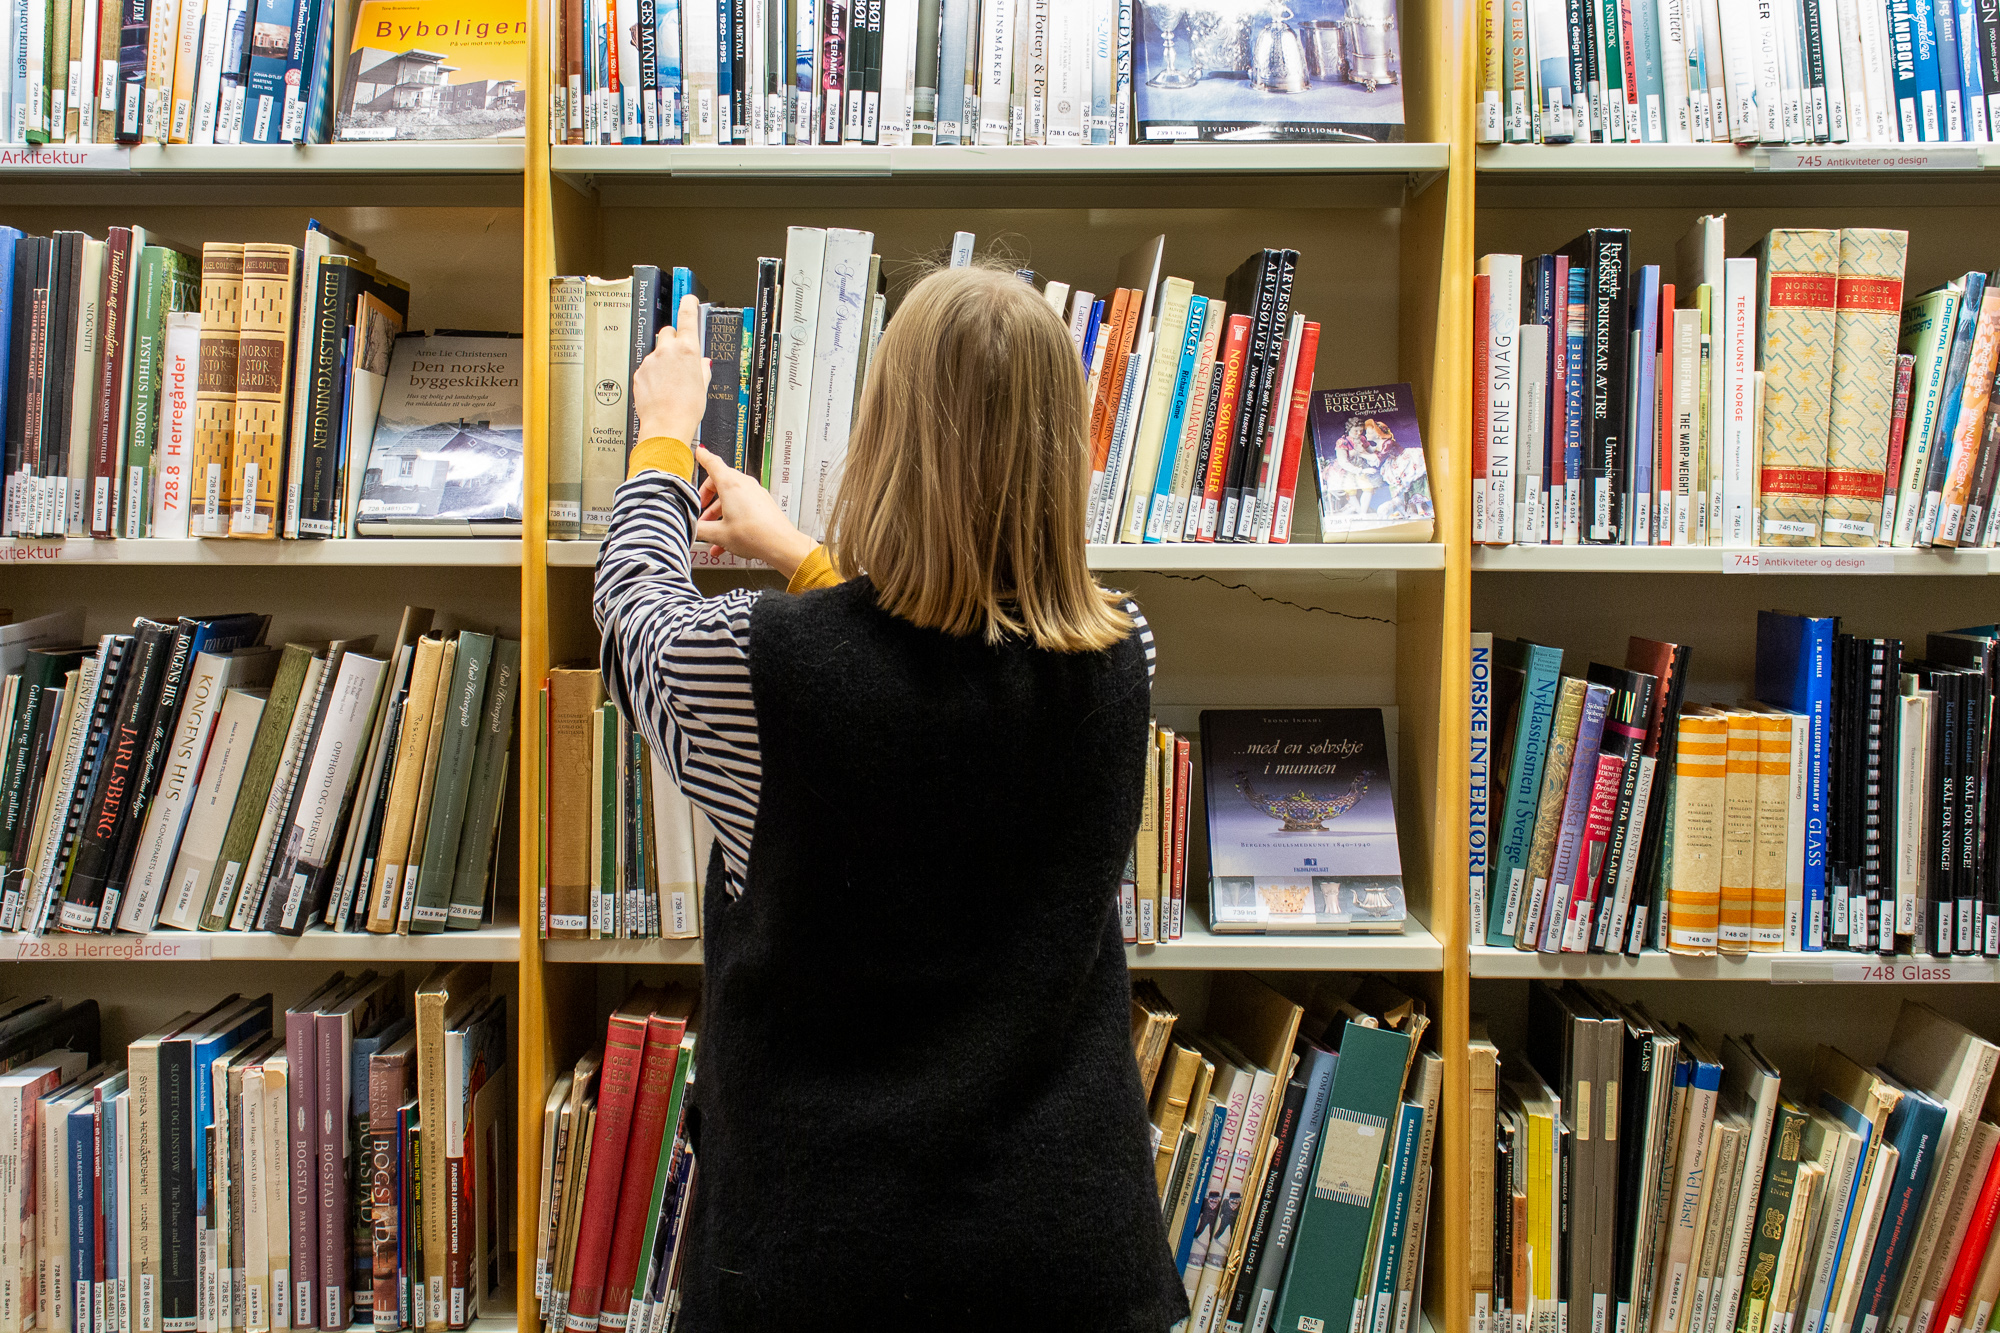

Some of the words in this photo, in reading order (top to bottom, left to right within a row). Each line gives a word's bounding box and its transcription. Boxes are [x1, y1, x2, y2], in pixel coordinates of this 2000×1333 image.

[184, 1, 198, 54] Byboligen
[376, 19, 526, 40] Byboligen
[854, 0, 866, 28] BØE
[868, 1, 880, 32] BØE
[1570, 12, 1580, 24] og
[1605, 4, 1616, 48] KNIVBOK
[642, 27, 655, 87] MYNTER
[1571, 26, 1581, 56] design
[1808, 1, 1822, 81] ANTIKVITETER
[829, 39, 839, 85] CERAMICS
[1571, 63, 1583, 91] Norge
[1, 150, 88, 165] Arkitektur
[1797, 156, 1822, 166] 745
[1827, 157, 1879, 166] Antikviteter
[1883, 158, 1895, 166] og
[1896, 156, 1928, 165] design
[1598, 242, 1610, 293] NORSKE
[1610, 243, 1621, 257] Per
[109, 249, 124, 294] Tradisjon
[1606, 259, 1621, 299] Gjærder
[1785, 281, 1823, 291] NORSK
[1852, 285, 1889, 294] NORSK
[107, 297, 119, 307] og
[551, 287, 583, 295] ENGLISH
[638, 280, 648, 306] Bredo
[1778, 292, 1829, 302] TEKSTIL
[1845, 295, 1894, 305] TEKSTIL
[1254, 262, 1278, 360] ARVESØLVET
[1270, 262, 1294, 360] ARVESØLVET
[1937, 298, 1954, 352] ORIENTAL
[106, 310, 118, 357] atmosfære
[1185, 306, 1204, 355] SILVER
[1596, 297, 1609, 372] DRIKKEKAR
[1681, 324, 1692, 355] MARTA
[1735, 296, 1745, 373] TEKSTILKUNST
[138, 336, 151, 391] LYSTHUS
[242, 345, 280, 358] NORSKE
[246, 360, 273, 373] STOR-
[313, 271, 338, 449] EIDSVOLLSBYGNINGEN
[411, 361, 445, 373] Den
[451, 362, 505, 374] norske
[415, 350, 437, 358] Arne
[440, 350, 452, 358] Lie
[455, 350, 508, 358] Christensen
[1198, 332, 1216, 378] CONCISE
[1494, 336, 1512, 391] SMAG
[241, 371, 279, 387] GÅRDER
[409, 375, 519, 389] byggeskikken
[1177, 370, 1189, 397] Richard
[1223, 349, 1241, 399] NORSKE
[1596, 374, 1607, 393] AV
[1680, 358, 1692, 405] HOFFMANN
[1930, 356, 1943, 387] RUGS
[167, 354, 187, 456] Herregårder
[1174, 400, 1185, 419] Came
[1324, 392, 1395, 406] EUROPEAN
[1325, 400, 1396, 413] PORCELAIN
[1569, 344, 1581, 448] BUNTPAPIERE
[1595, 395, 1607, 418] TRE
[1735, 385, 1743, 422] NORGE
[134, 402, 148, 447] NORGE
[1185, 381, 1206, 450] HALLMARKS
[1493, 400, 1510, 444] RENE
[1679, 413, 1690, 430] THE
[1918, 400, 1935, 454] CARPETS
[1962, 408, 1980, 450] HANNAH
[1208, 403, 1234, 492] SØLVSTEMPLER
[164, 465, 180, 510] 728.8
[1911, 459, 1922, 490] S.REED
[1955, 451, 1972, 489] RYGGEN
[1778, 523, 1793, 532] 746
[1794, 524, 1805, 532] Nor
[689, 550, 736, 566] 738.1
[1734, 555, 1759, 567] 745
[1765, 556, 1819, 568] Antikviteter
[1821, 558, 1832, 568] og
[1835, 556, 1865, 568] design
[167, 633, 191, 683] KONGENS
[161, 685, 177, 706] HUS
[1471, 648, 1488, 732] NORSKE
[176, 674, 215, 760] KONGENS
[1284, 742, 1302, 754] en
[1307, 739, 1364, 758] sølvskje
[1519, 678, 1556, 794] Nyklassicismen
[95, 724, 138, 839] JARLSBERG
[164, 764, 186, 801] HUS
[323, 741, 343, 788] OPPHØYD
[1264, 762, 1270, 774] i
[1275, 763, 1337, 775] munnen
[1623, 742, 1642, 797] VINGLASS
[319, 790, 331, 805] OG
[1636, 766, 1652, 817] ARNSTEIN
[1964, 775, 1977, 801] SKÅL
[1469, 737, 1488, 905] INTERIØR
[1619, 800, 1630, 821] FRA
[1964, 804, 1974, 825] FOR
[303, 807, 327, 857] OVERSETT
[1504, 809, 1532, 863] Sverige
[1625, 820, 1642, 873] BERNTSEN
[1808, 818, 1822, 867] GLASS
[1963, 828, 1974, 868] NORGE!
[1607, 826, 1626, 885] HADELAND
[552, 918, 569, 927] 739.1
[570, 919, 583, 927] Gre
[19, 942, 69, 957] 728.8
[75, 939, 180, 957] Herregårder
[1862, 966, 1897, 980] 748
[1902, 966, 1951, 981] Glass
[1641, 1041, 1652, 1072] GLASS
[170, 1064, 180, 1108] SLOTTET
[171, 1110, 180, 1125] OG
[1221, 1091, 1244, 1146] SKARPT
[1242, 1092, 1265, 1146] SKARPT
[1426, 1099, 1436, 1125] OLAF
[171, 1128, 180, 1173] LINSTOW
[1294, 1130, 1316, 1179] Norske
[1403, 1118, 1415, 1155] HALLGEIR
[296, 1140, 307, 1205] BOGSTAD
[323, 1144, 334, 1208] BOGSTAD
[1212, 1148, 1229, 1183] SETT
[1232, 1149, 1251, 1184] SETT
[1399, 1157, 1409, 1185] OPEDAL
[1414, 1129, 1432, 1214] GULBRANSSON
[1686, 1168, 1704, 1188] Vel
[372, 1140, 390, 1242] BOGSTAD
[1394, 1192, 1404, 1220] GRAFFS
[1746, 1165, 1764, 1211] NORSKE
[325, 1213, 333, 1236] PARK
[1276, 1180, 1301, 1249] Julehefter
[1679, 1191, 1697, 1229] blåst!
[325, 1239, 334, 1251] OG
[1391, 1222, 1399, 1237] BOK
[325, 1255, 334, 1284] HAGER
